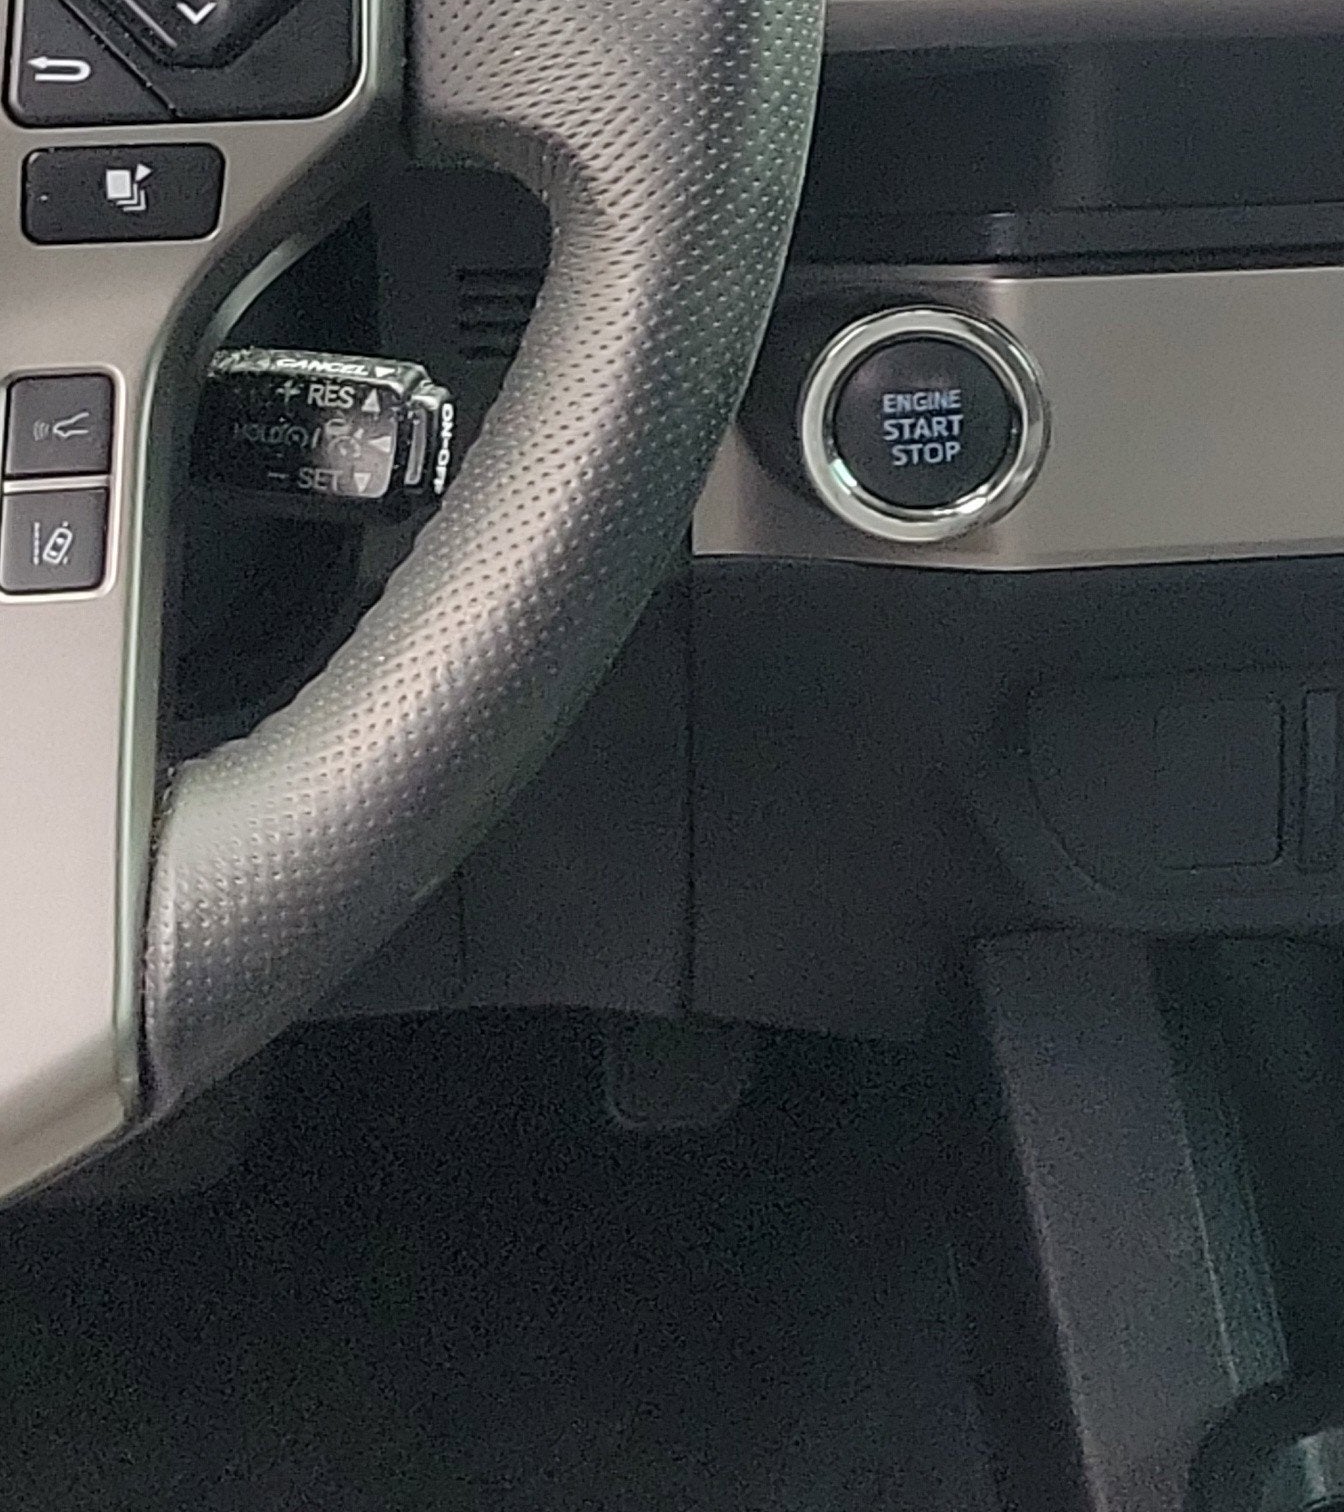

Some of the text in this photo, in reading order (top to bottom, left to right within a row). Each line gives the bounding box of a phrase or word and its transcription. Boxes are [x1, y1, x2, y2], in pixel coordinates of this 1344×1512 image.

[275, 358, 370, 375] CANCEL
[307, 385, 355, 409] RES
[882, 389, 962, 413] ENGINE
[882, 415, 963, 441] START
[891, 442, 961, 466] STOP
[297, 468, 343, 490] SET
